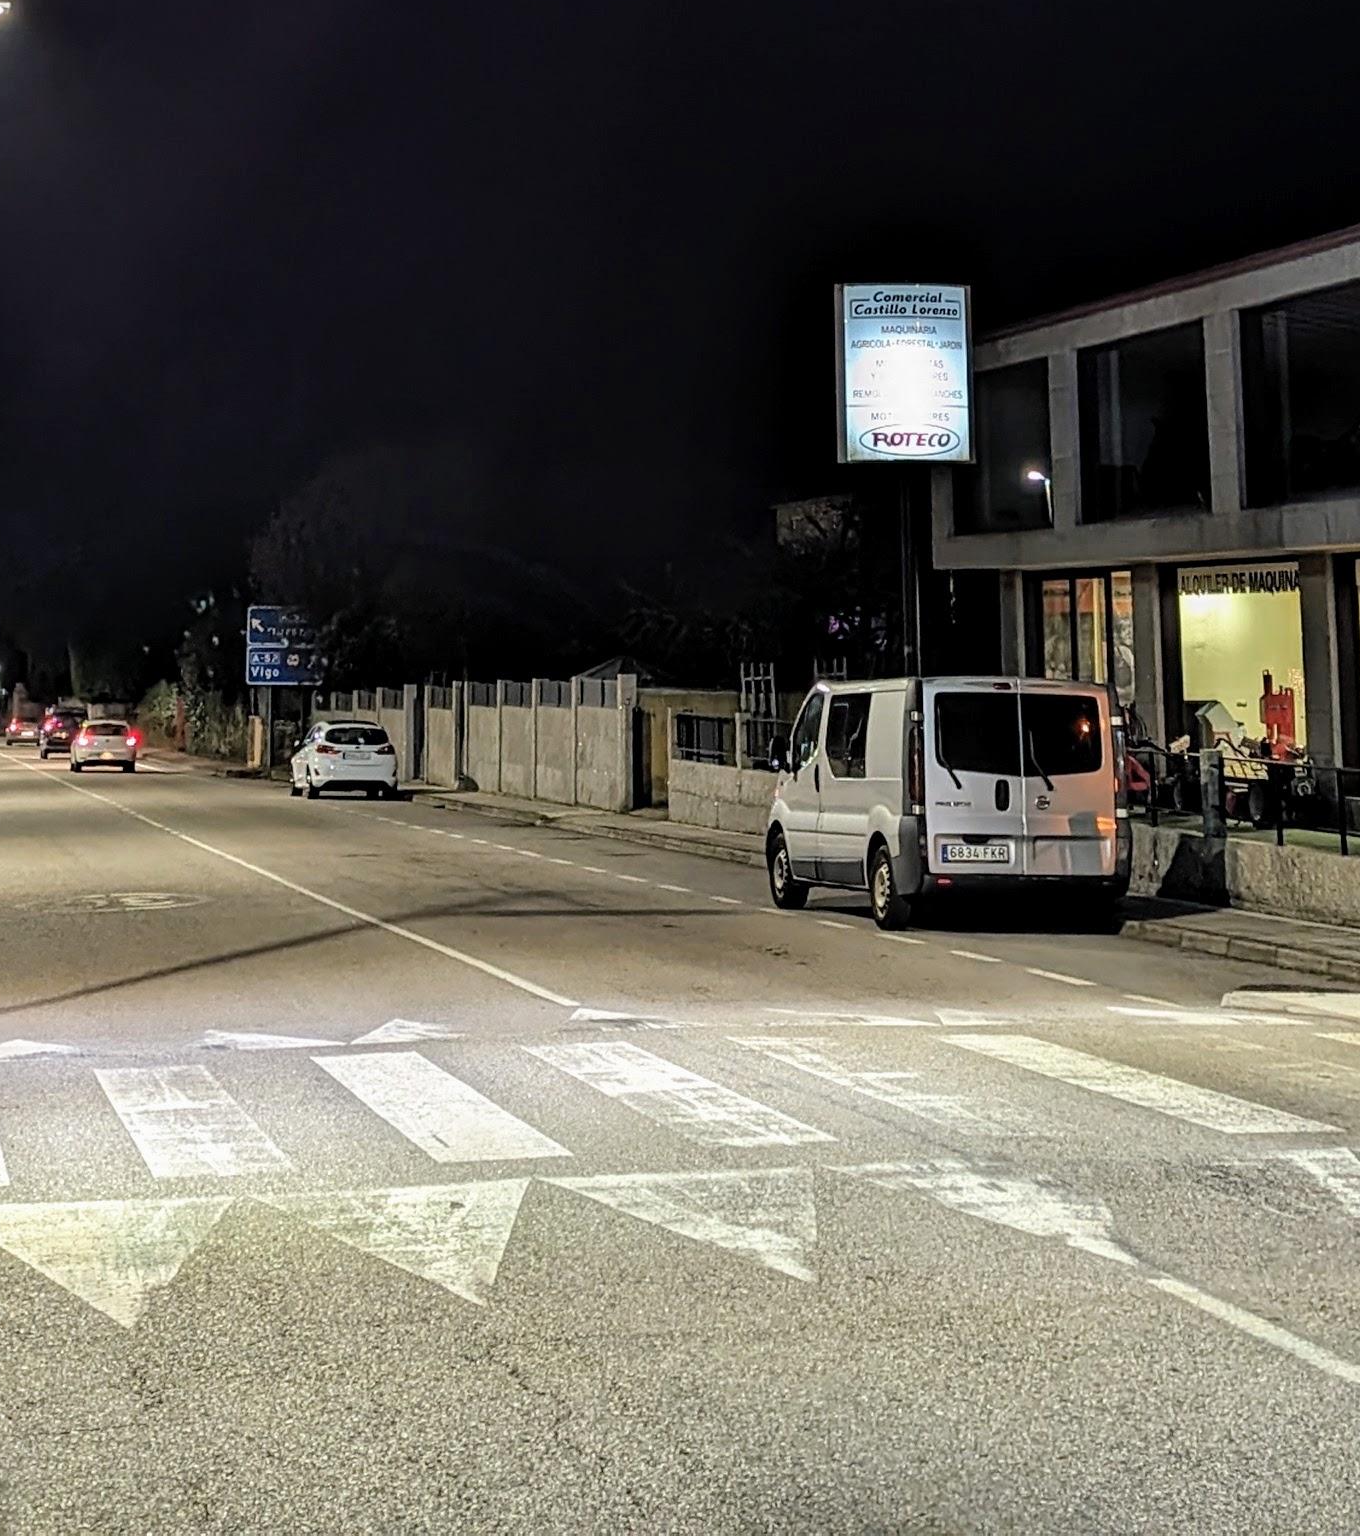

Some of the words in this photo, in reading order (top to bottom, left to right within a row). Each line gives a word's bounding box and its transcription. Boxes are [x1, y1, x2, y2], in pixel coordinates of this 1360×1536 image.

[873, 291, 942, 303] Comercial
[854, 304, 907, 316] Castillo
[912, 304, 958, 316] Lorenzo
[881, 325, 937, 335] MAQUINARIA
[871, 432, 951, 449] ROTECO
[1181, 573, 1228, 595] ALQUILER
[1232, 572, 1245, 593] DE
[1249, 569, 1300, 595] MAQUINA
[251, 666, 279, 679] Vigo
[950, 847, 980, 858] 6834
[983, 847, 1005, 858] FKR
